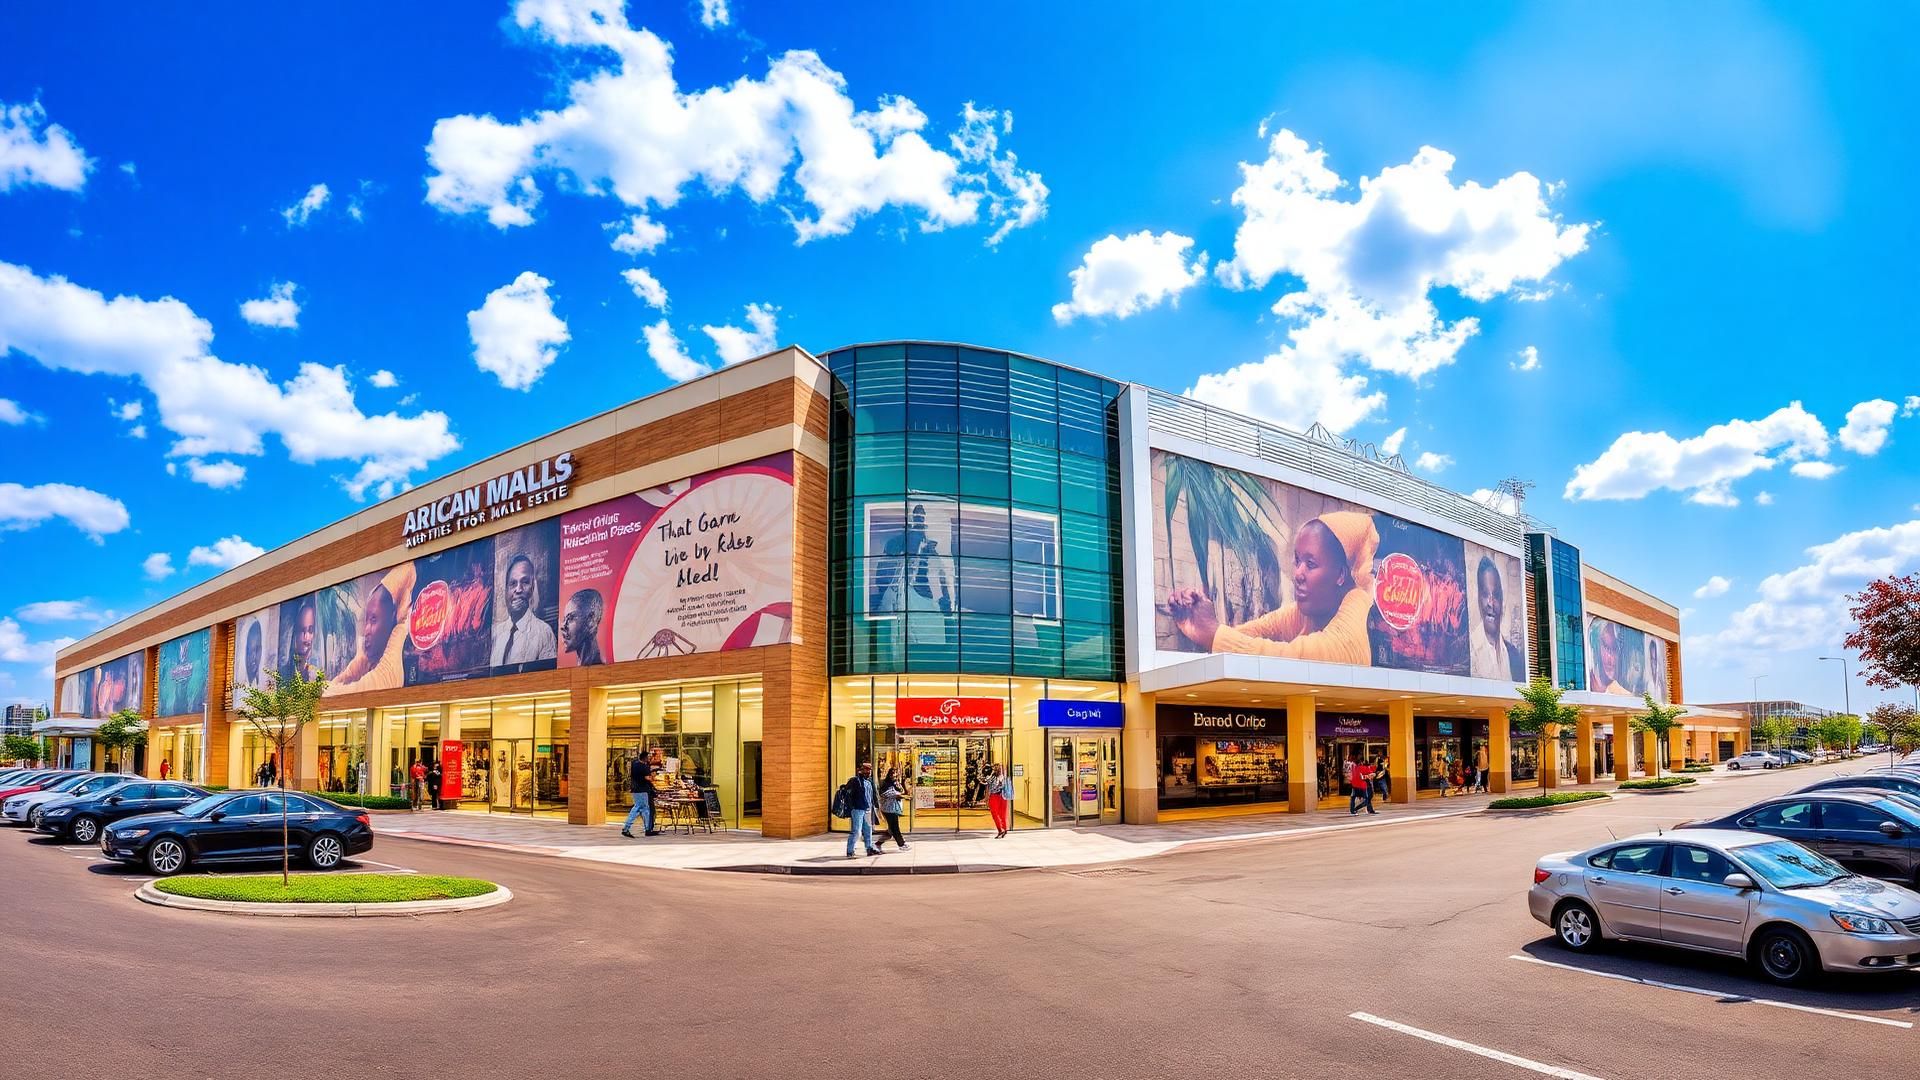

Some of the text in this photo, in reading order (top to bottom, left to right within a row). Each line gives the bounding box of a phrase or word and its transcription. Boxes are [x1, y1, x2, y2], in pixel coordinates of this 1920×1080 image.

[402, 452, 572, 537] ARICAN MALLS
[657, 519, 692, 542] That
